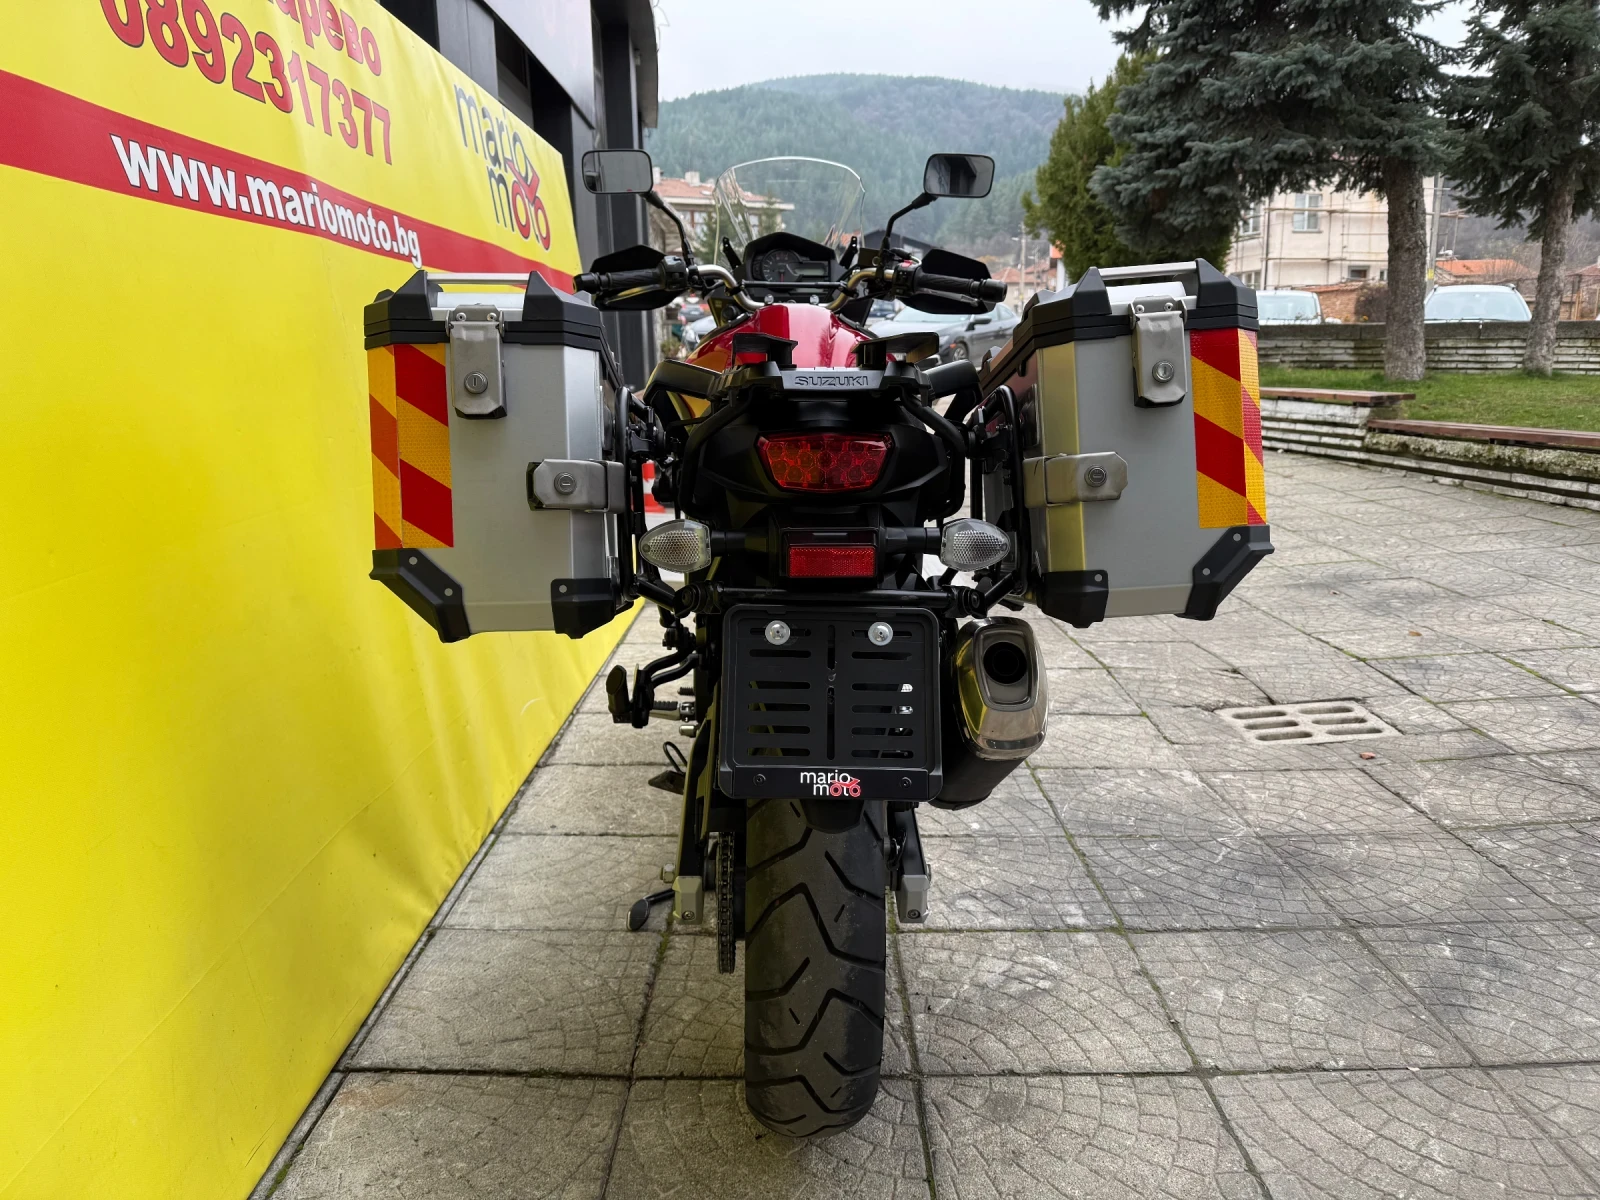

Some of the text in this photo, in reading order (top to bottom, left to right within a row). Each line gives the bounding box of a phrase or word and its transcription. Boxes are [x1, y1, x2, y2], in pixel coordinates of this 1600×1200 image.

[268, 0, 381, 76] рево
[454, 84, 529, 183] mario
[109, 133, 422, 269] www.mariomoto.bg
[487, 166, 551, 251] moto
[794, 375, 869, 387] SUZUKI
[800, 769, 851, 784] mario
[813, 783, 861, 798] moto
